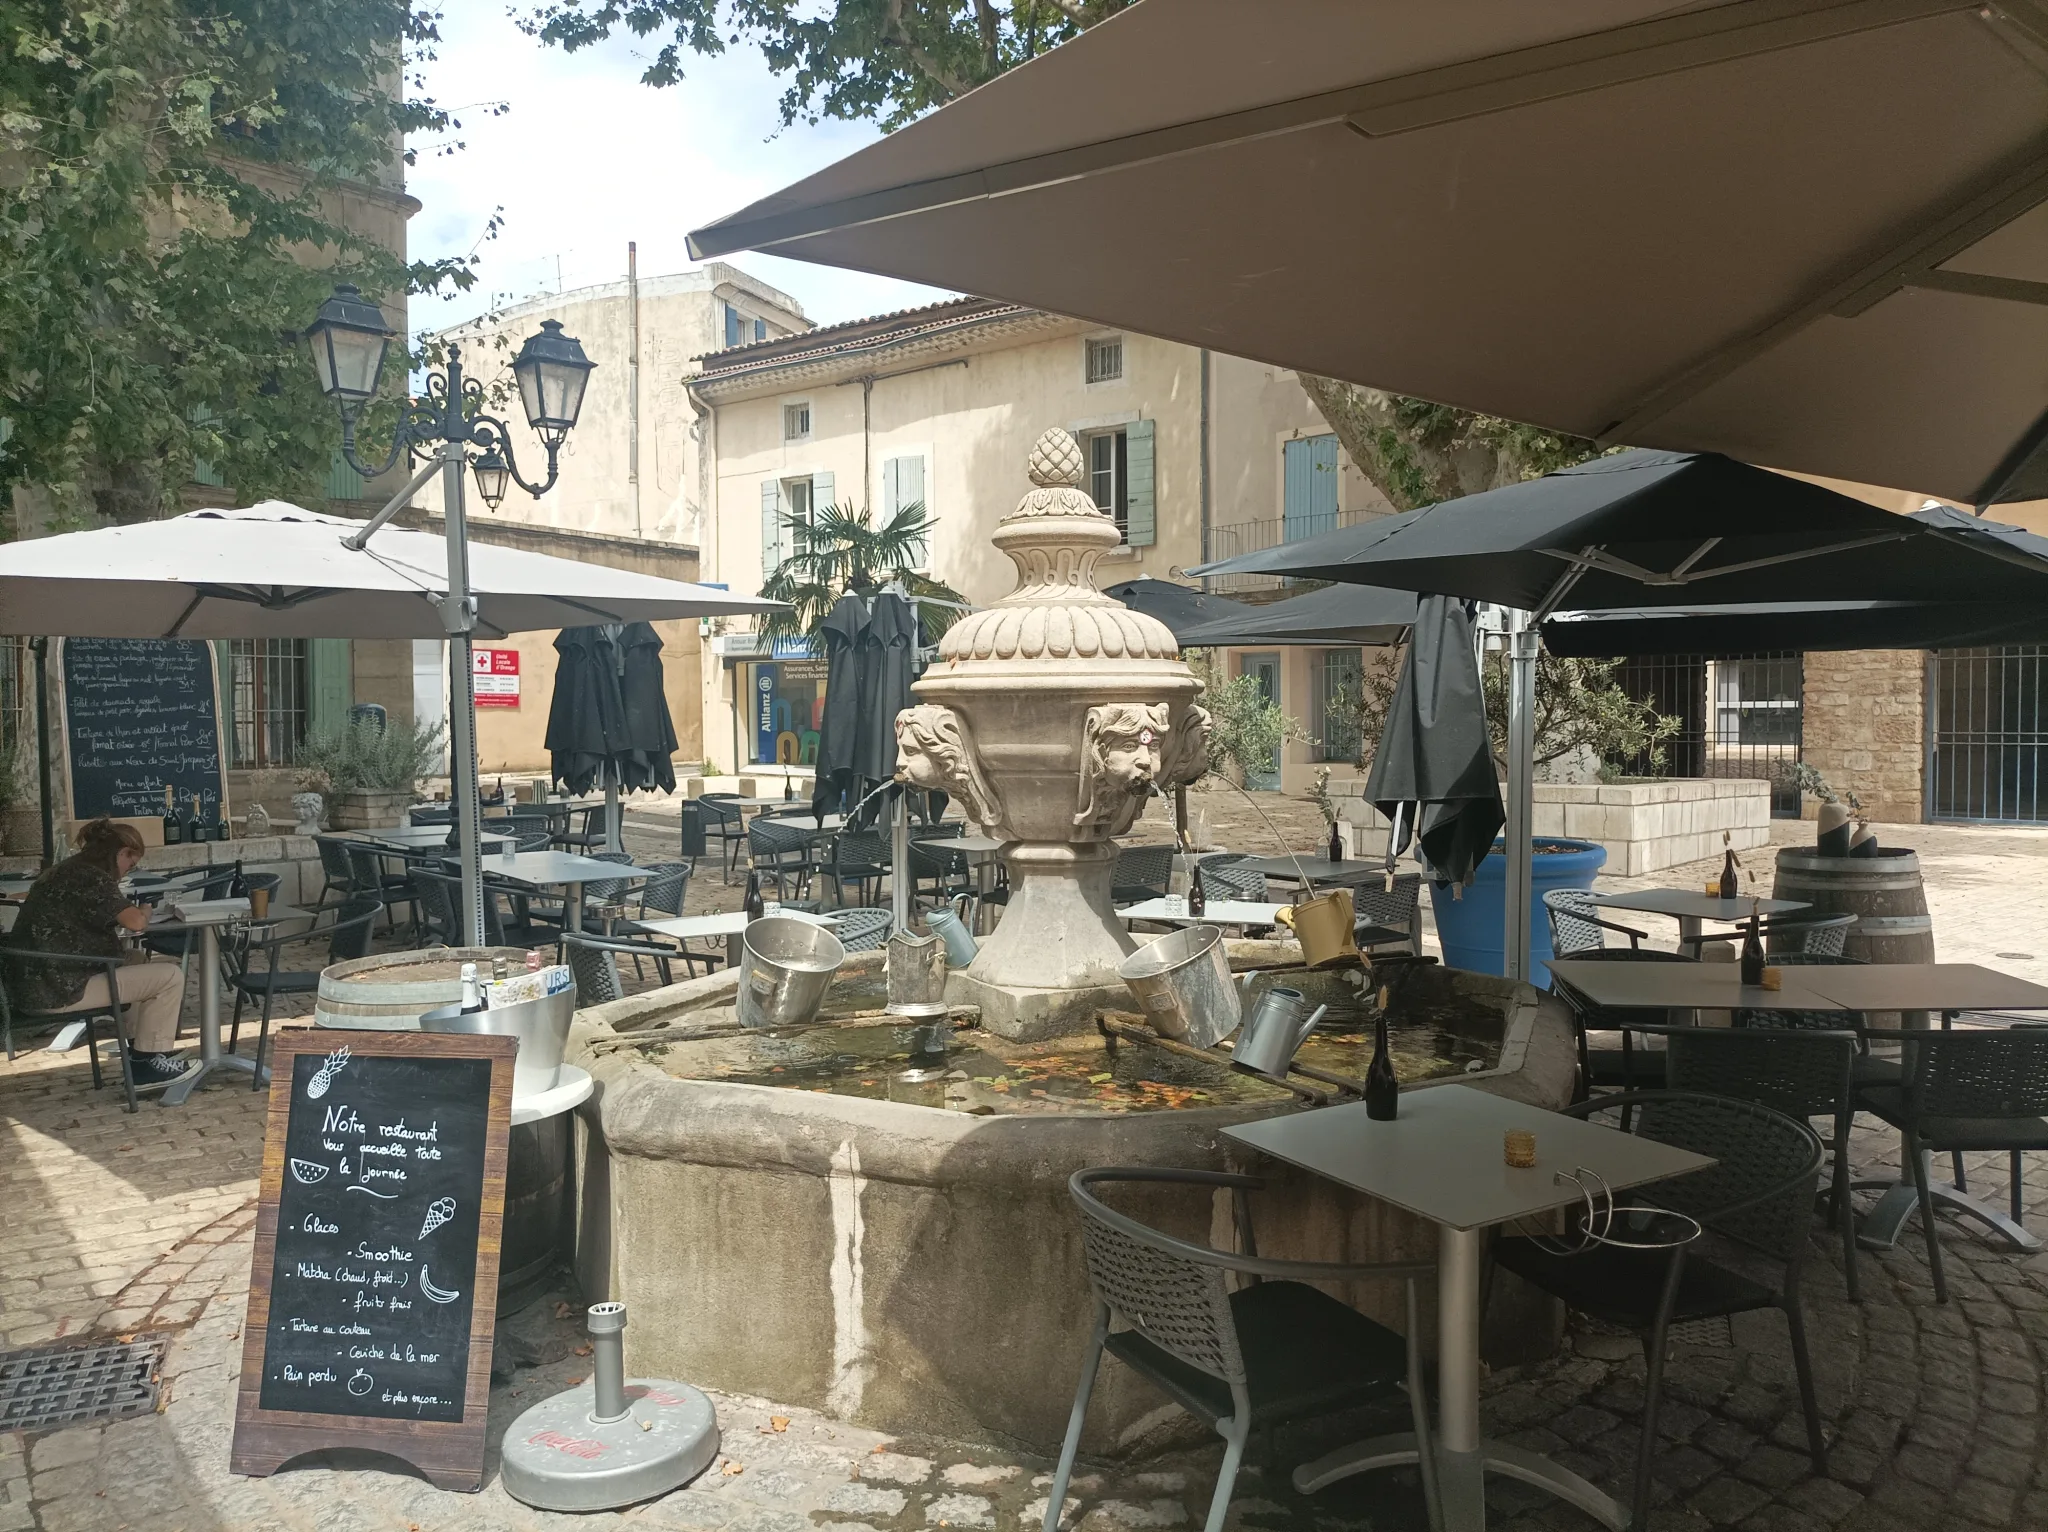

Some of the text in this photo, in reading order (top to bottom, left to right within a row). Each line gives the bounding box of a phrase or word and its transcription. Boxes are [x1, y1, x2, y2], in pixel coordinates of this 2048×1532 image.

[761, 693, 771, 732] Allianz
[322, 1105, 438, 1142] Notre restaurant
[360, 1143, 407, 1158] accueille
[415, 1145, 442, 1160] toute
[340, 1156, 407, 1183] la journée
[303, 1213, 339, 1233] Glaces
[355, 1241, 413, 1262] Smoothie
[297, 1262, 332, 1281] Matcha
[335, 1267, 370, 1285] (chaud,
[353, 1290, 413, 1312] fruits frais
[290, 1318, 319, 1332] Tartare
[322, 1326, 336, 1334] au
[349, 1343, 440, 1363] Ceviche de la mer
[283, 1364, 337, 1387] Pain perdu
[382, 1388, 391, 1401] et
